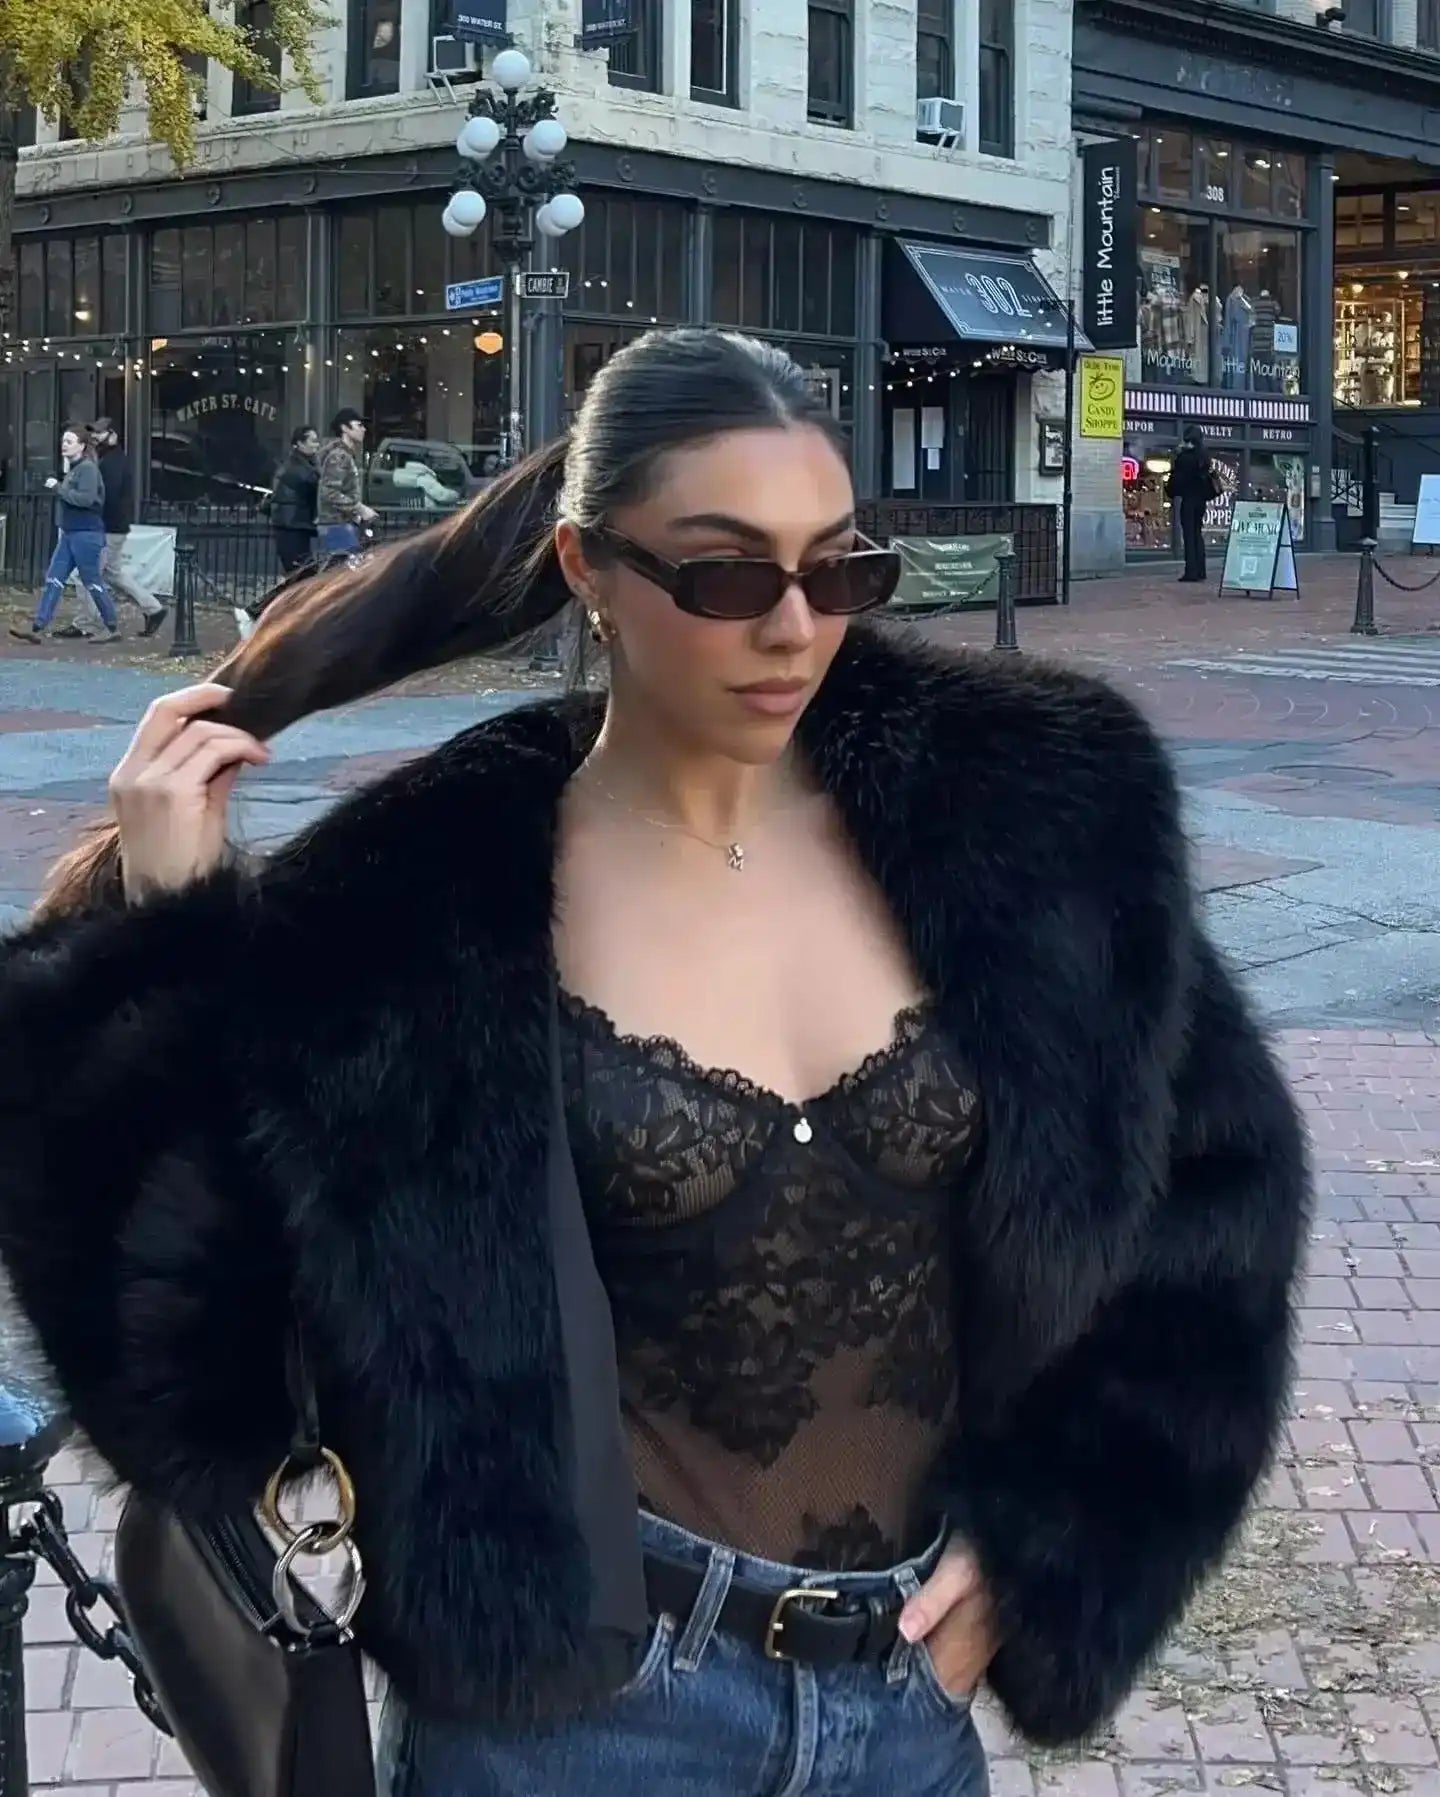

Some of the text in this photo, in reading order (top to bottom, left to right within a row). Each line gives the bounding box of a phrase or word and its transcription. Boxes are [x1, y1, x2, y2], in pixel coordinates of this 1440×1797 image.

[470, 16, 493, 28] WATER
[1205, 185, 1225, 202] 308
[1096, 166, 1114, 326] little Mountain
[527, 277, 554, 293] CAMBIE
[964, 272, 1033, 318] 302
[176, 396, 218, 422] WATER
[1087, 403, 1116, 416] CANDY
[1085, 416, 1118, 430] SHOPPE
[1262, 429, 1293, 441] RETRO
